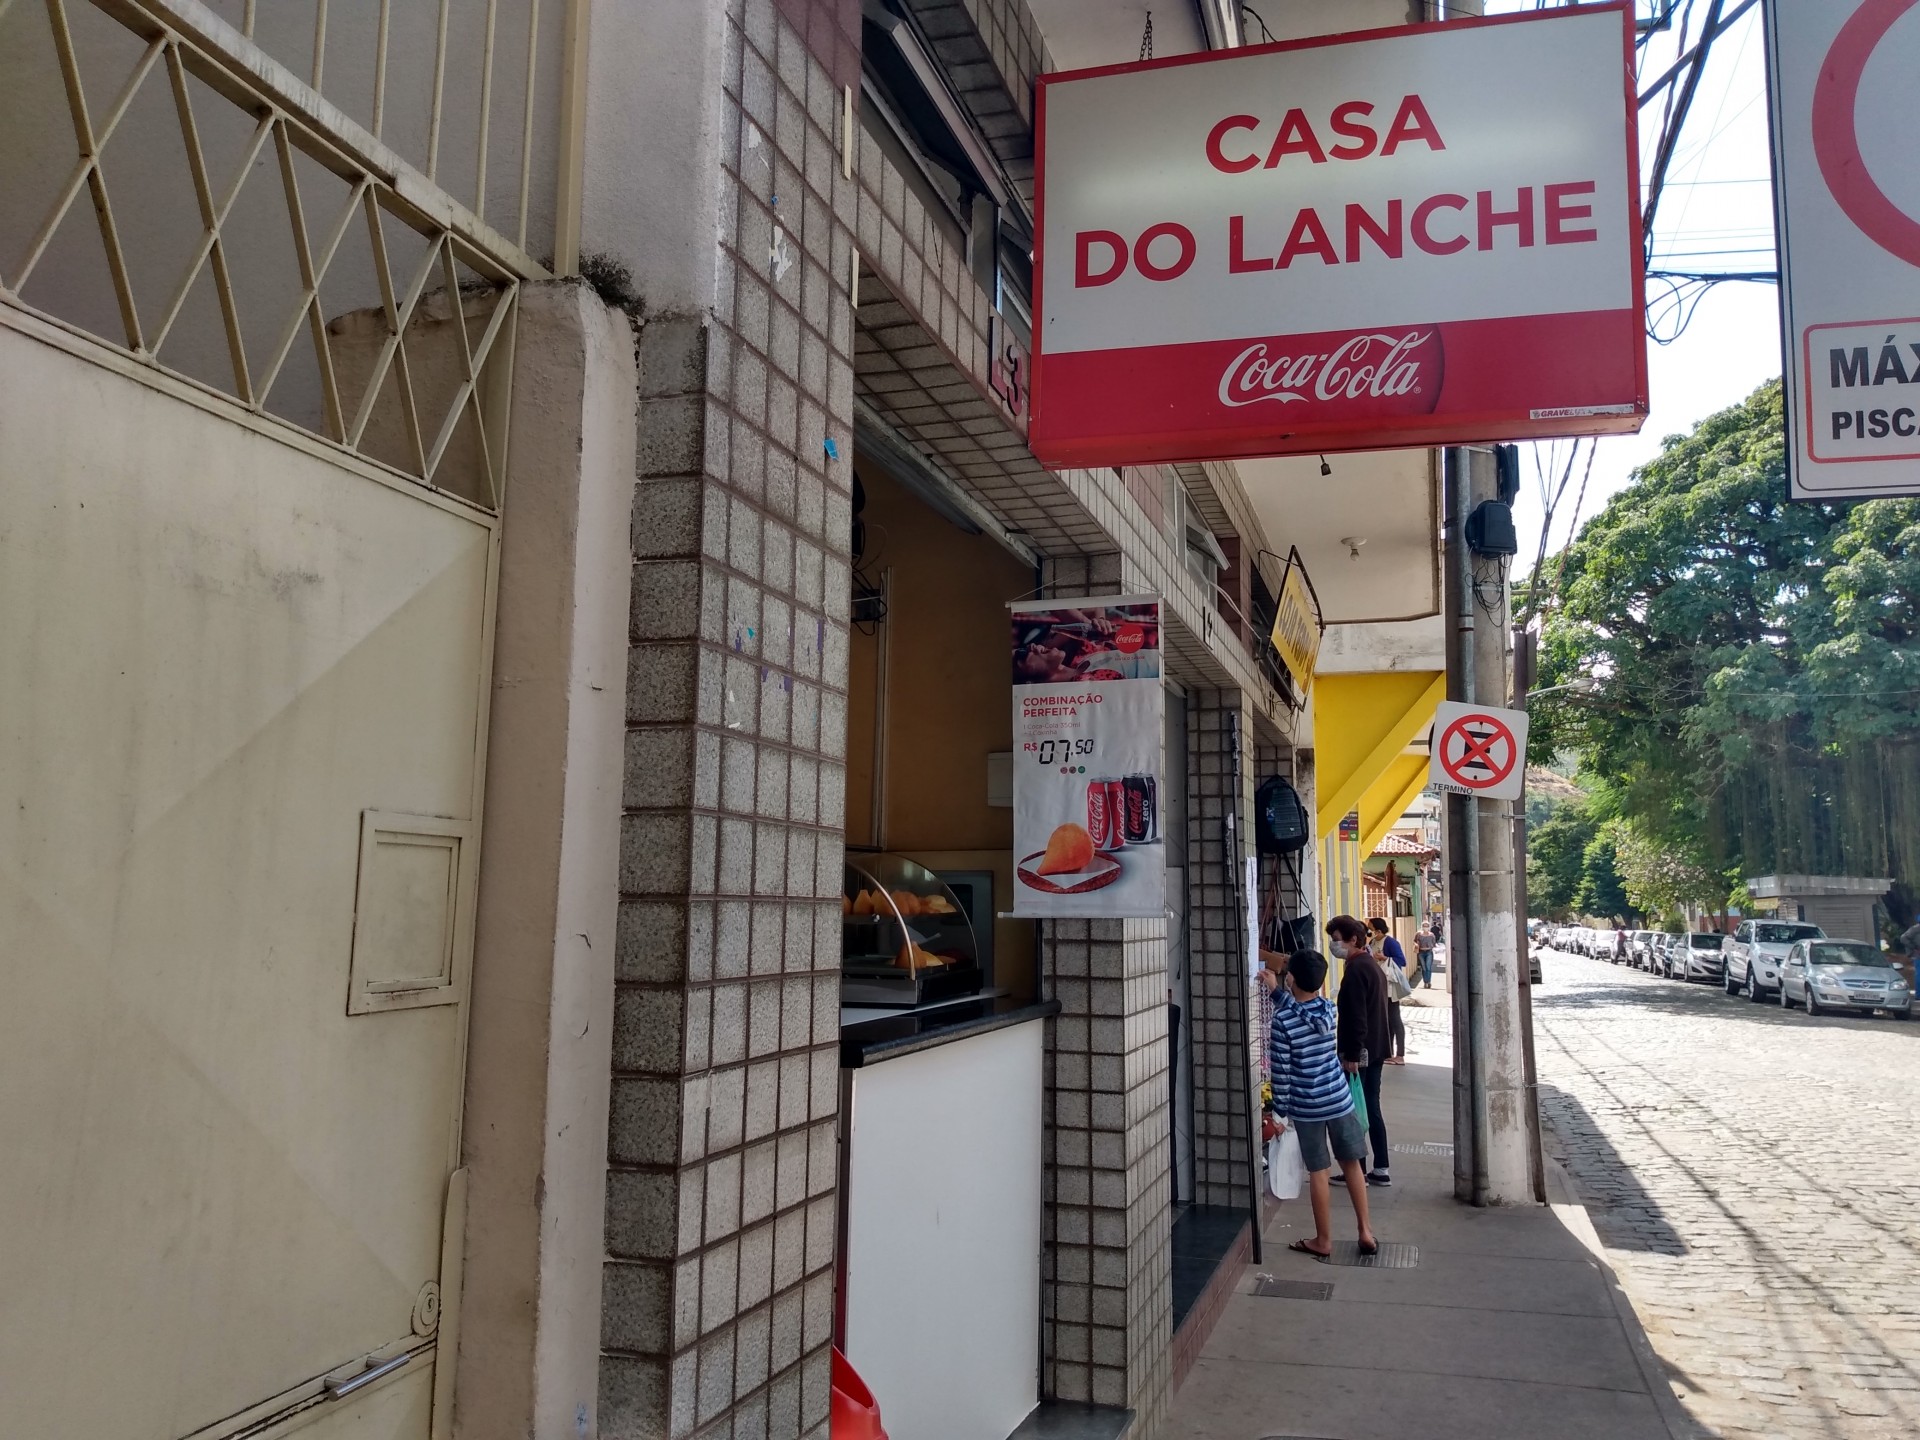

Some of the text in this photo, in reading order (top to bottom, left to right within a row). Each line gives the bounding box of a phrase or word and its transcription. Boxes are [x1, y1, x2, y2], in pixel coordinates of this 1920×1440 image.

[1205, 94, 1446, 174] CASA
[1074, 180, 1598, 289] DO LANCHE
[1218, 331, 1433, 407] Coca-Cola
[1831, 407, 1920, 440] PISC
[1023, 693, 1103, 706] COMBINAÇÃO
[1023, 707, 1077, 717] PERFEITA
[1023, 742, 1038, 752] R$
[1432, 782, 1474, 795] TERMINO
